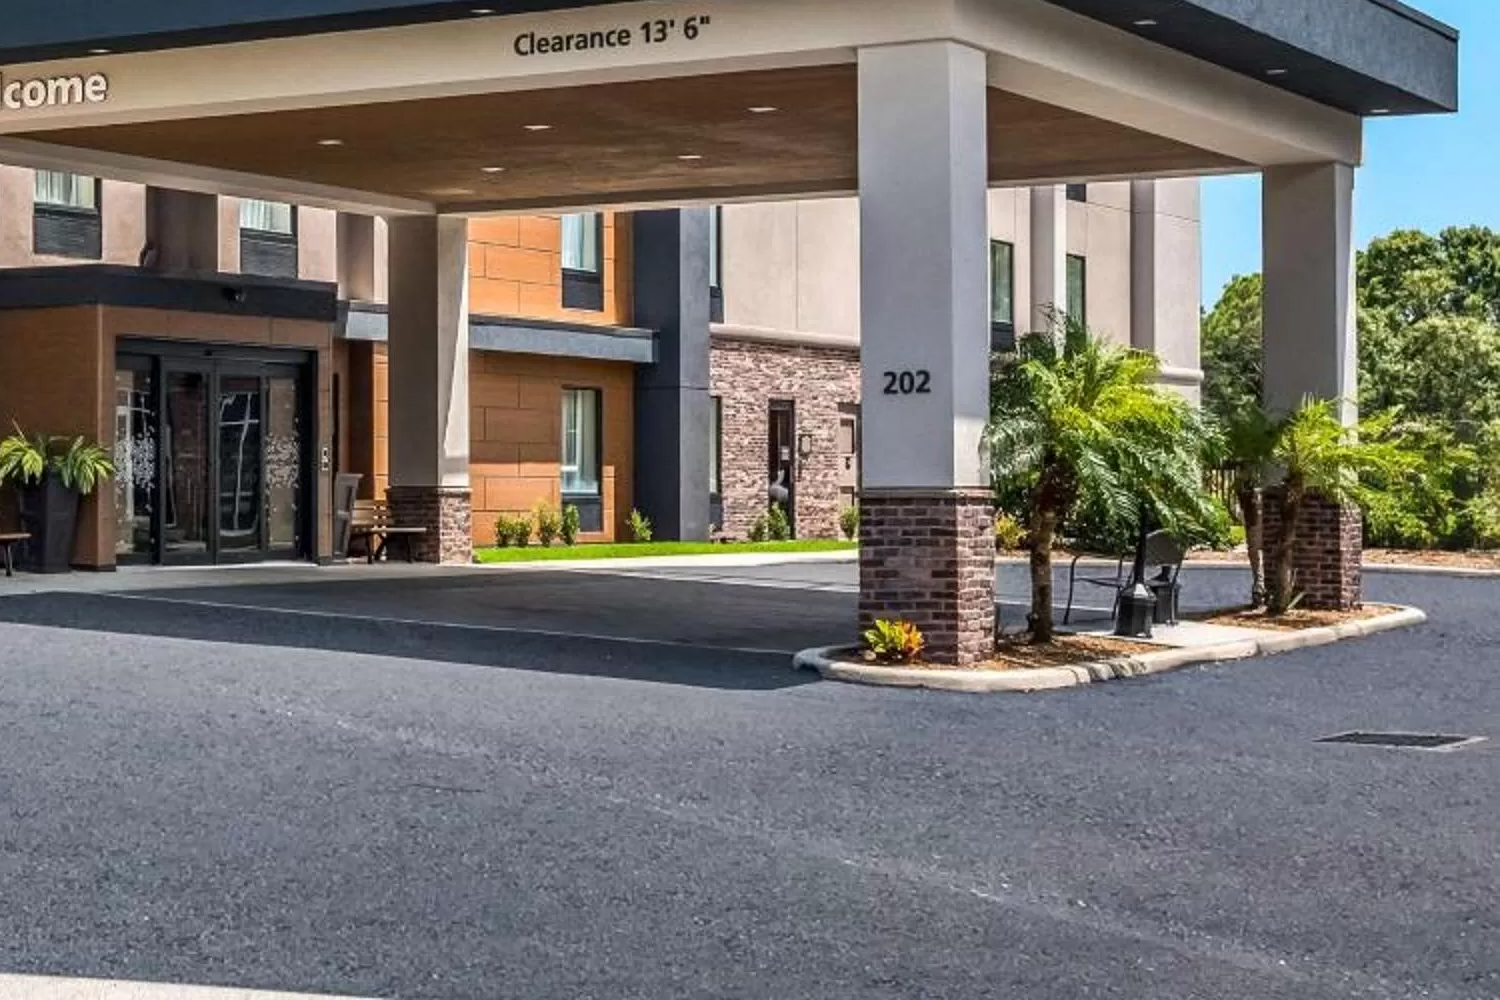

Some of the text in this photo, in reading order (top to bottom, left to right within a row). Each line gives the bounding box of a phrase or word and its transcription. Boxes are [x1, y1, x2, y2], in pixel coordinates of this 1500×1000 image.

[513, 15, 712, 56] Clearance 13' 6"
[883, 369, 932, 395] 202
